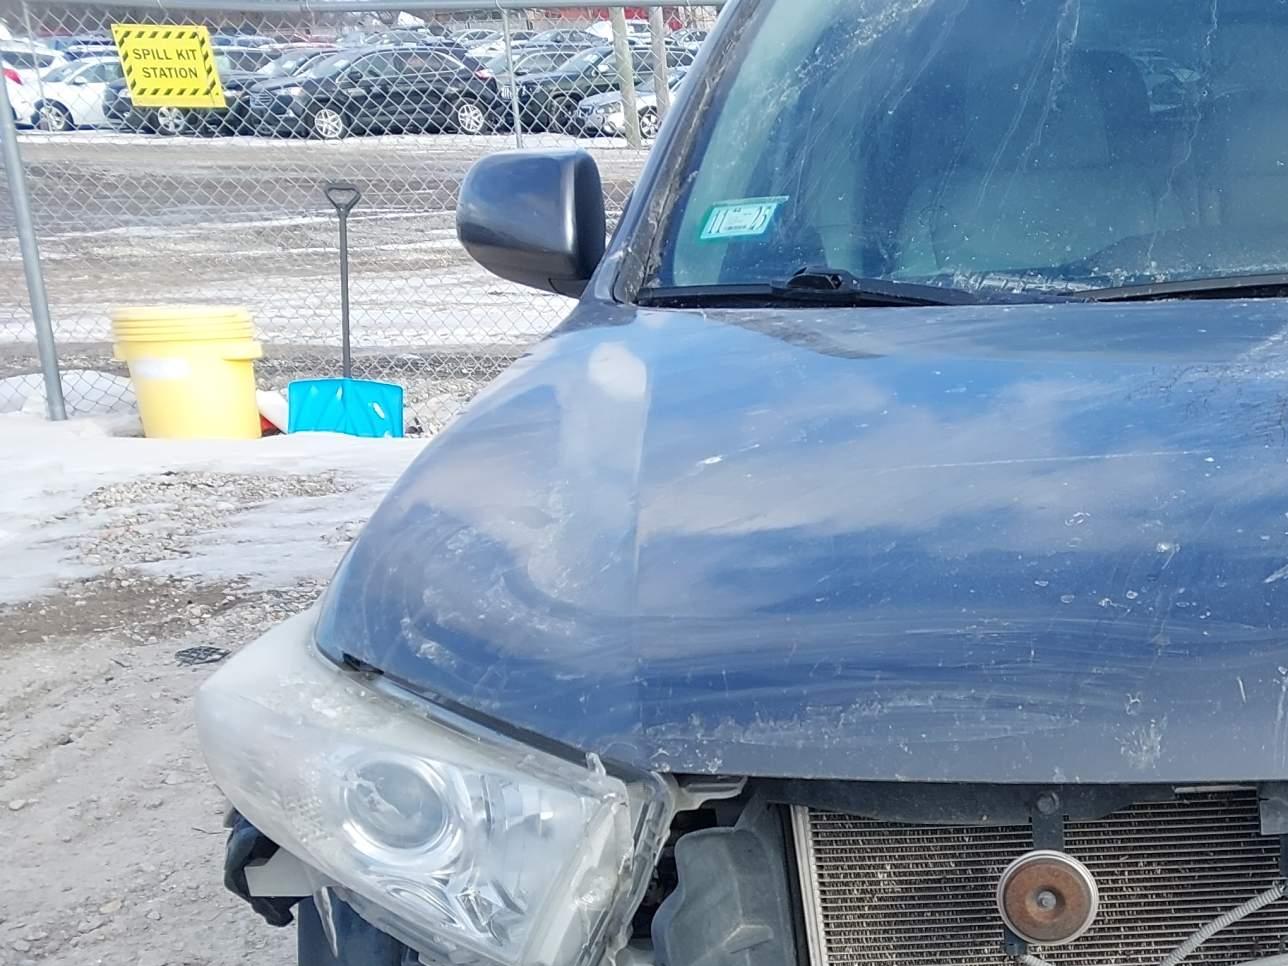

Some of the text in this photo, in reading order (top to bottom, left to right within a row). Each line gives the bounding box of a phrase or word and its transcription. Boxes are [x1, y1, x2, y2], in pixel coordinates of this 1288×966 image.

[132, 48, 197, 61] SPILL KIT
[142, 66, 198, 79] STATION
